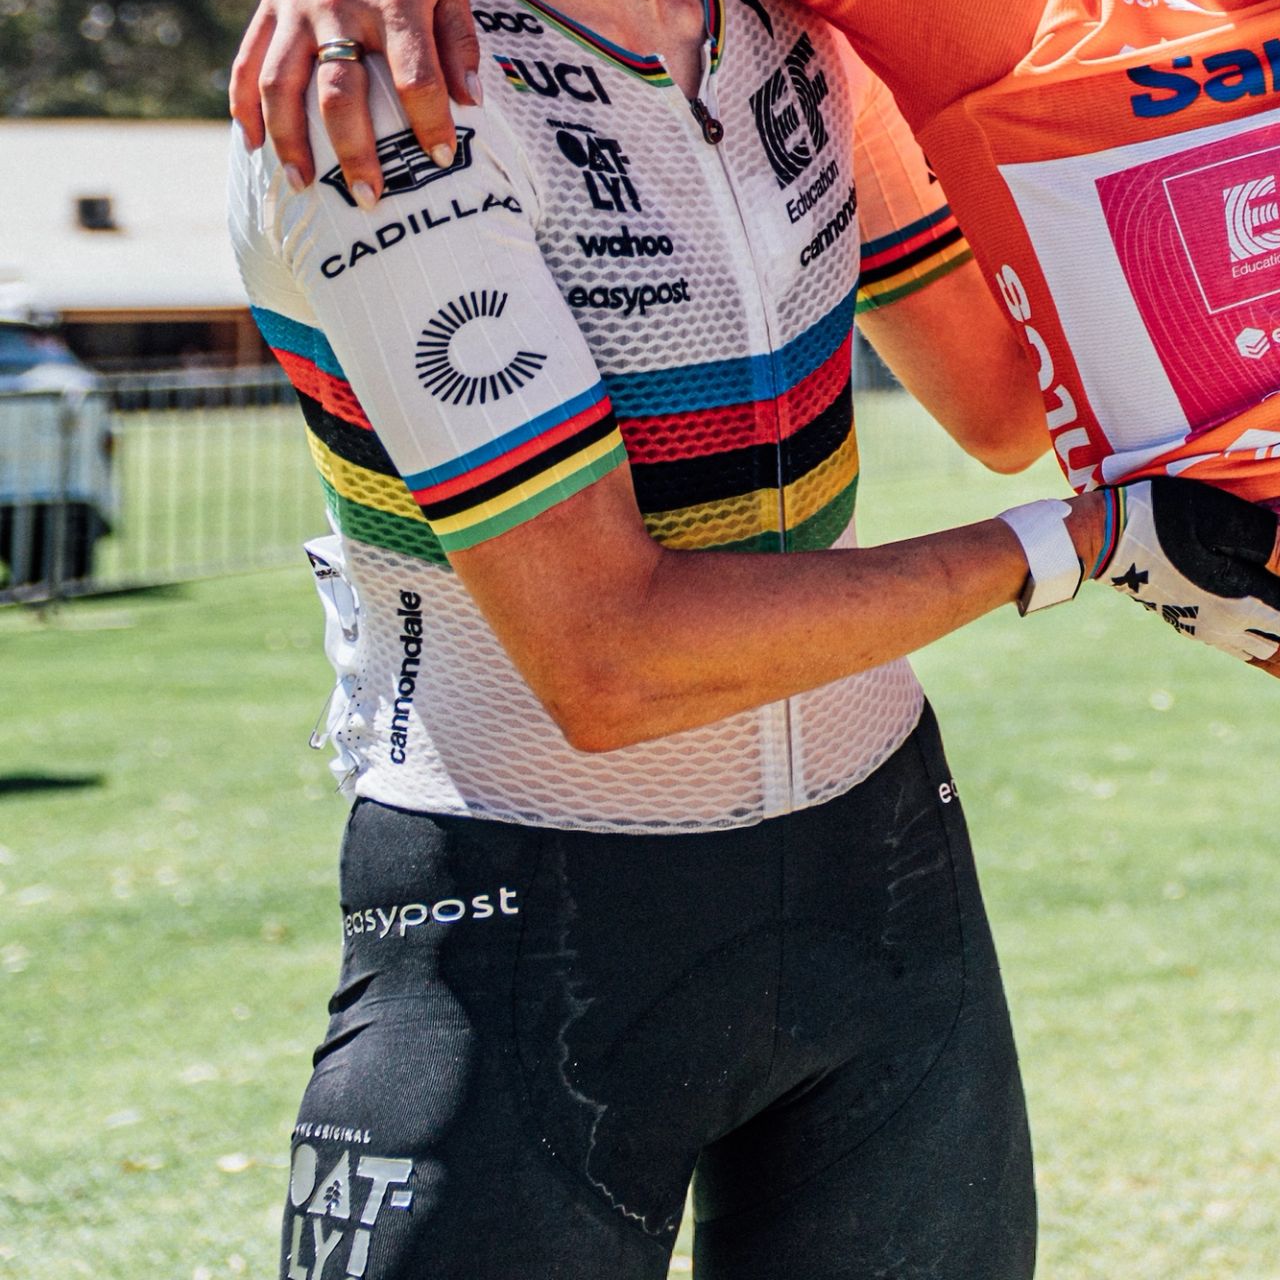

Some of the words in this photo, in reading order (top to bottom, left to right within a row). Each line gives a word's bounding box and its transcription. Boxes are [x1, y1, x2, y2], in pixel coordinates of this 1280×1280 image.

[510, 57, 612, 105] UCI
[786, 160, 839, 224] Education
[320, 193, 523, 279] CADILLAC
[577, 226, 674, 258] wahoo
[567, 276, 691, 316] easypost
[390, 589, 422, 764] cannondale
